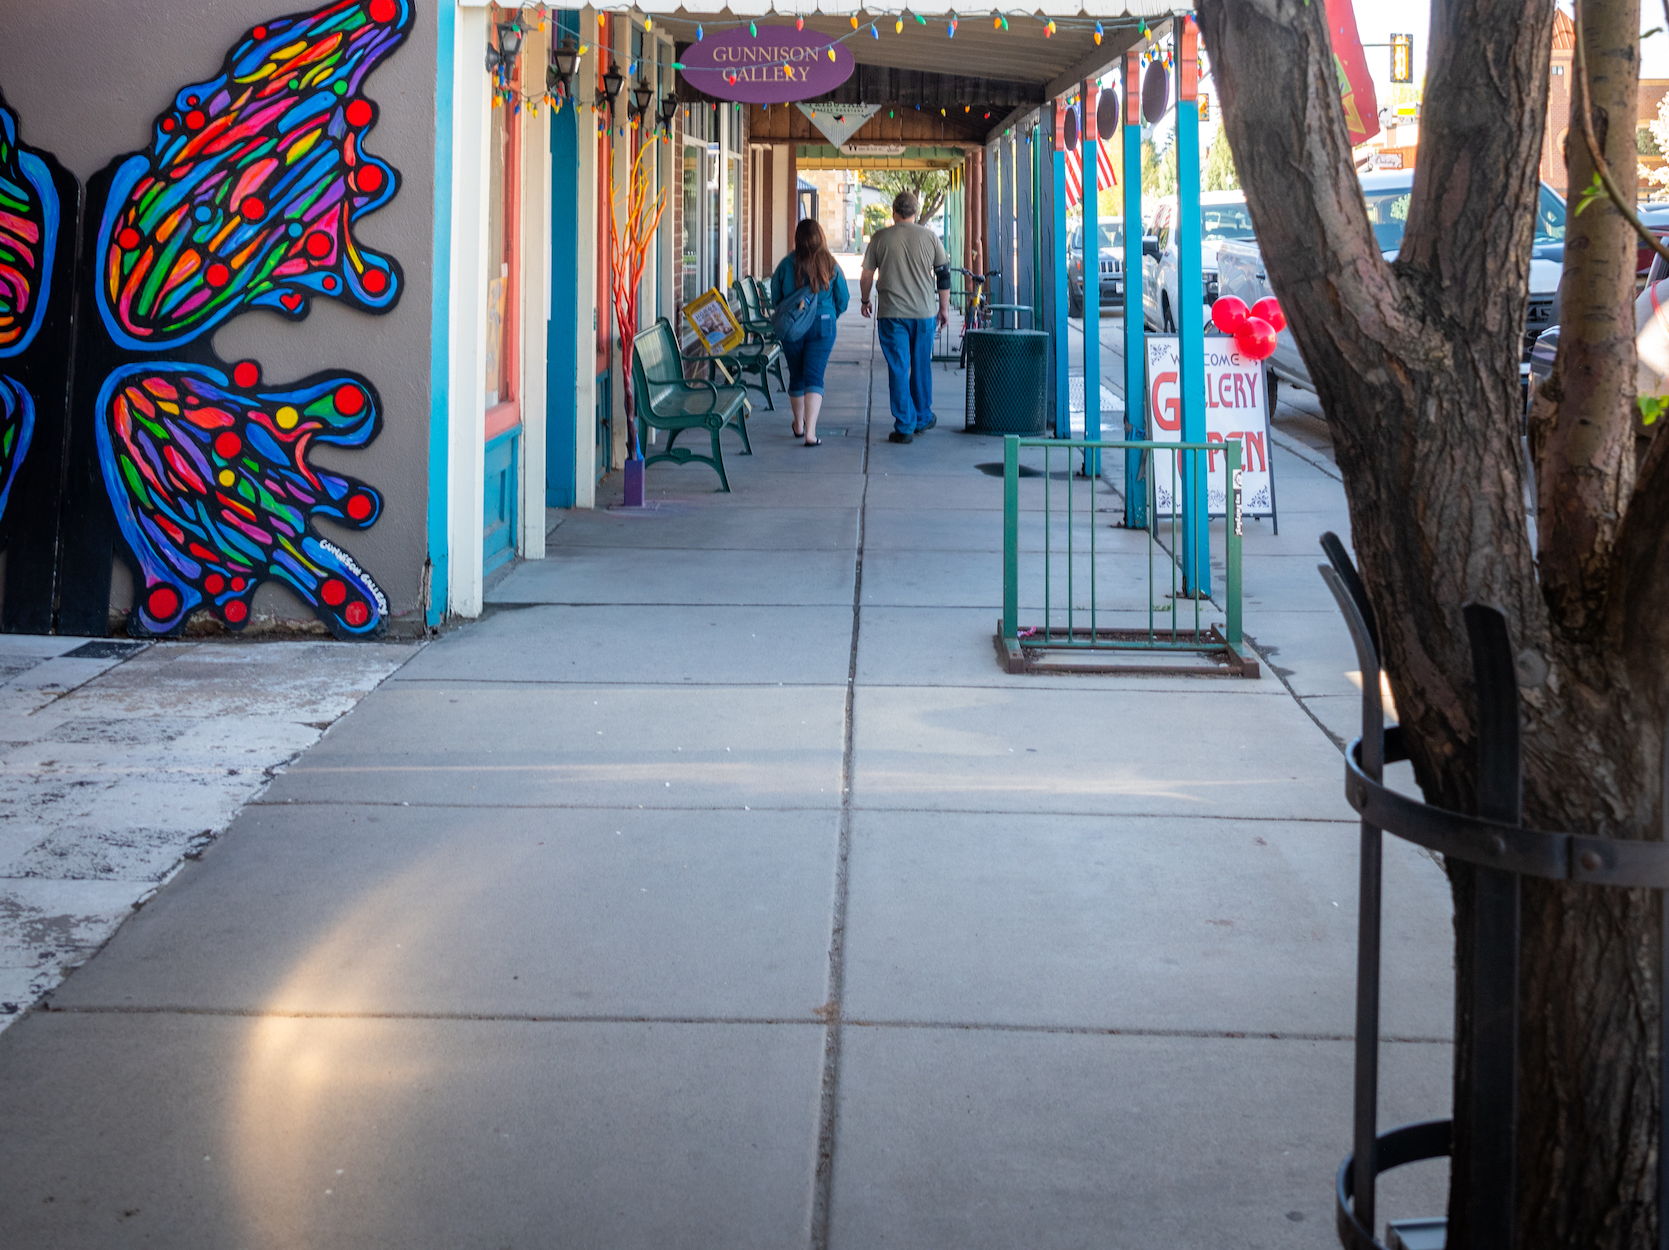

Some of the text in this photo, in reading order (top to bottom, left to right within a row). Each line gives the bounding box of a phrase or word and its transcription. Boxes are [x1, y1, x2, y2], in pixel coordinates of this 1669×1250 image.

[712, 46, 820, 63] GUNNISON
[722, 66, 811, 83] GALLERY
[1170, 353, 1240, 367] WCOME
[1152, 371, 1258, 431] GLERY
[1177, 431, 1267, 476] PN
